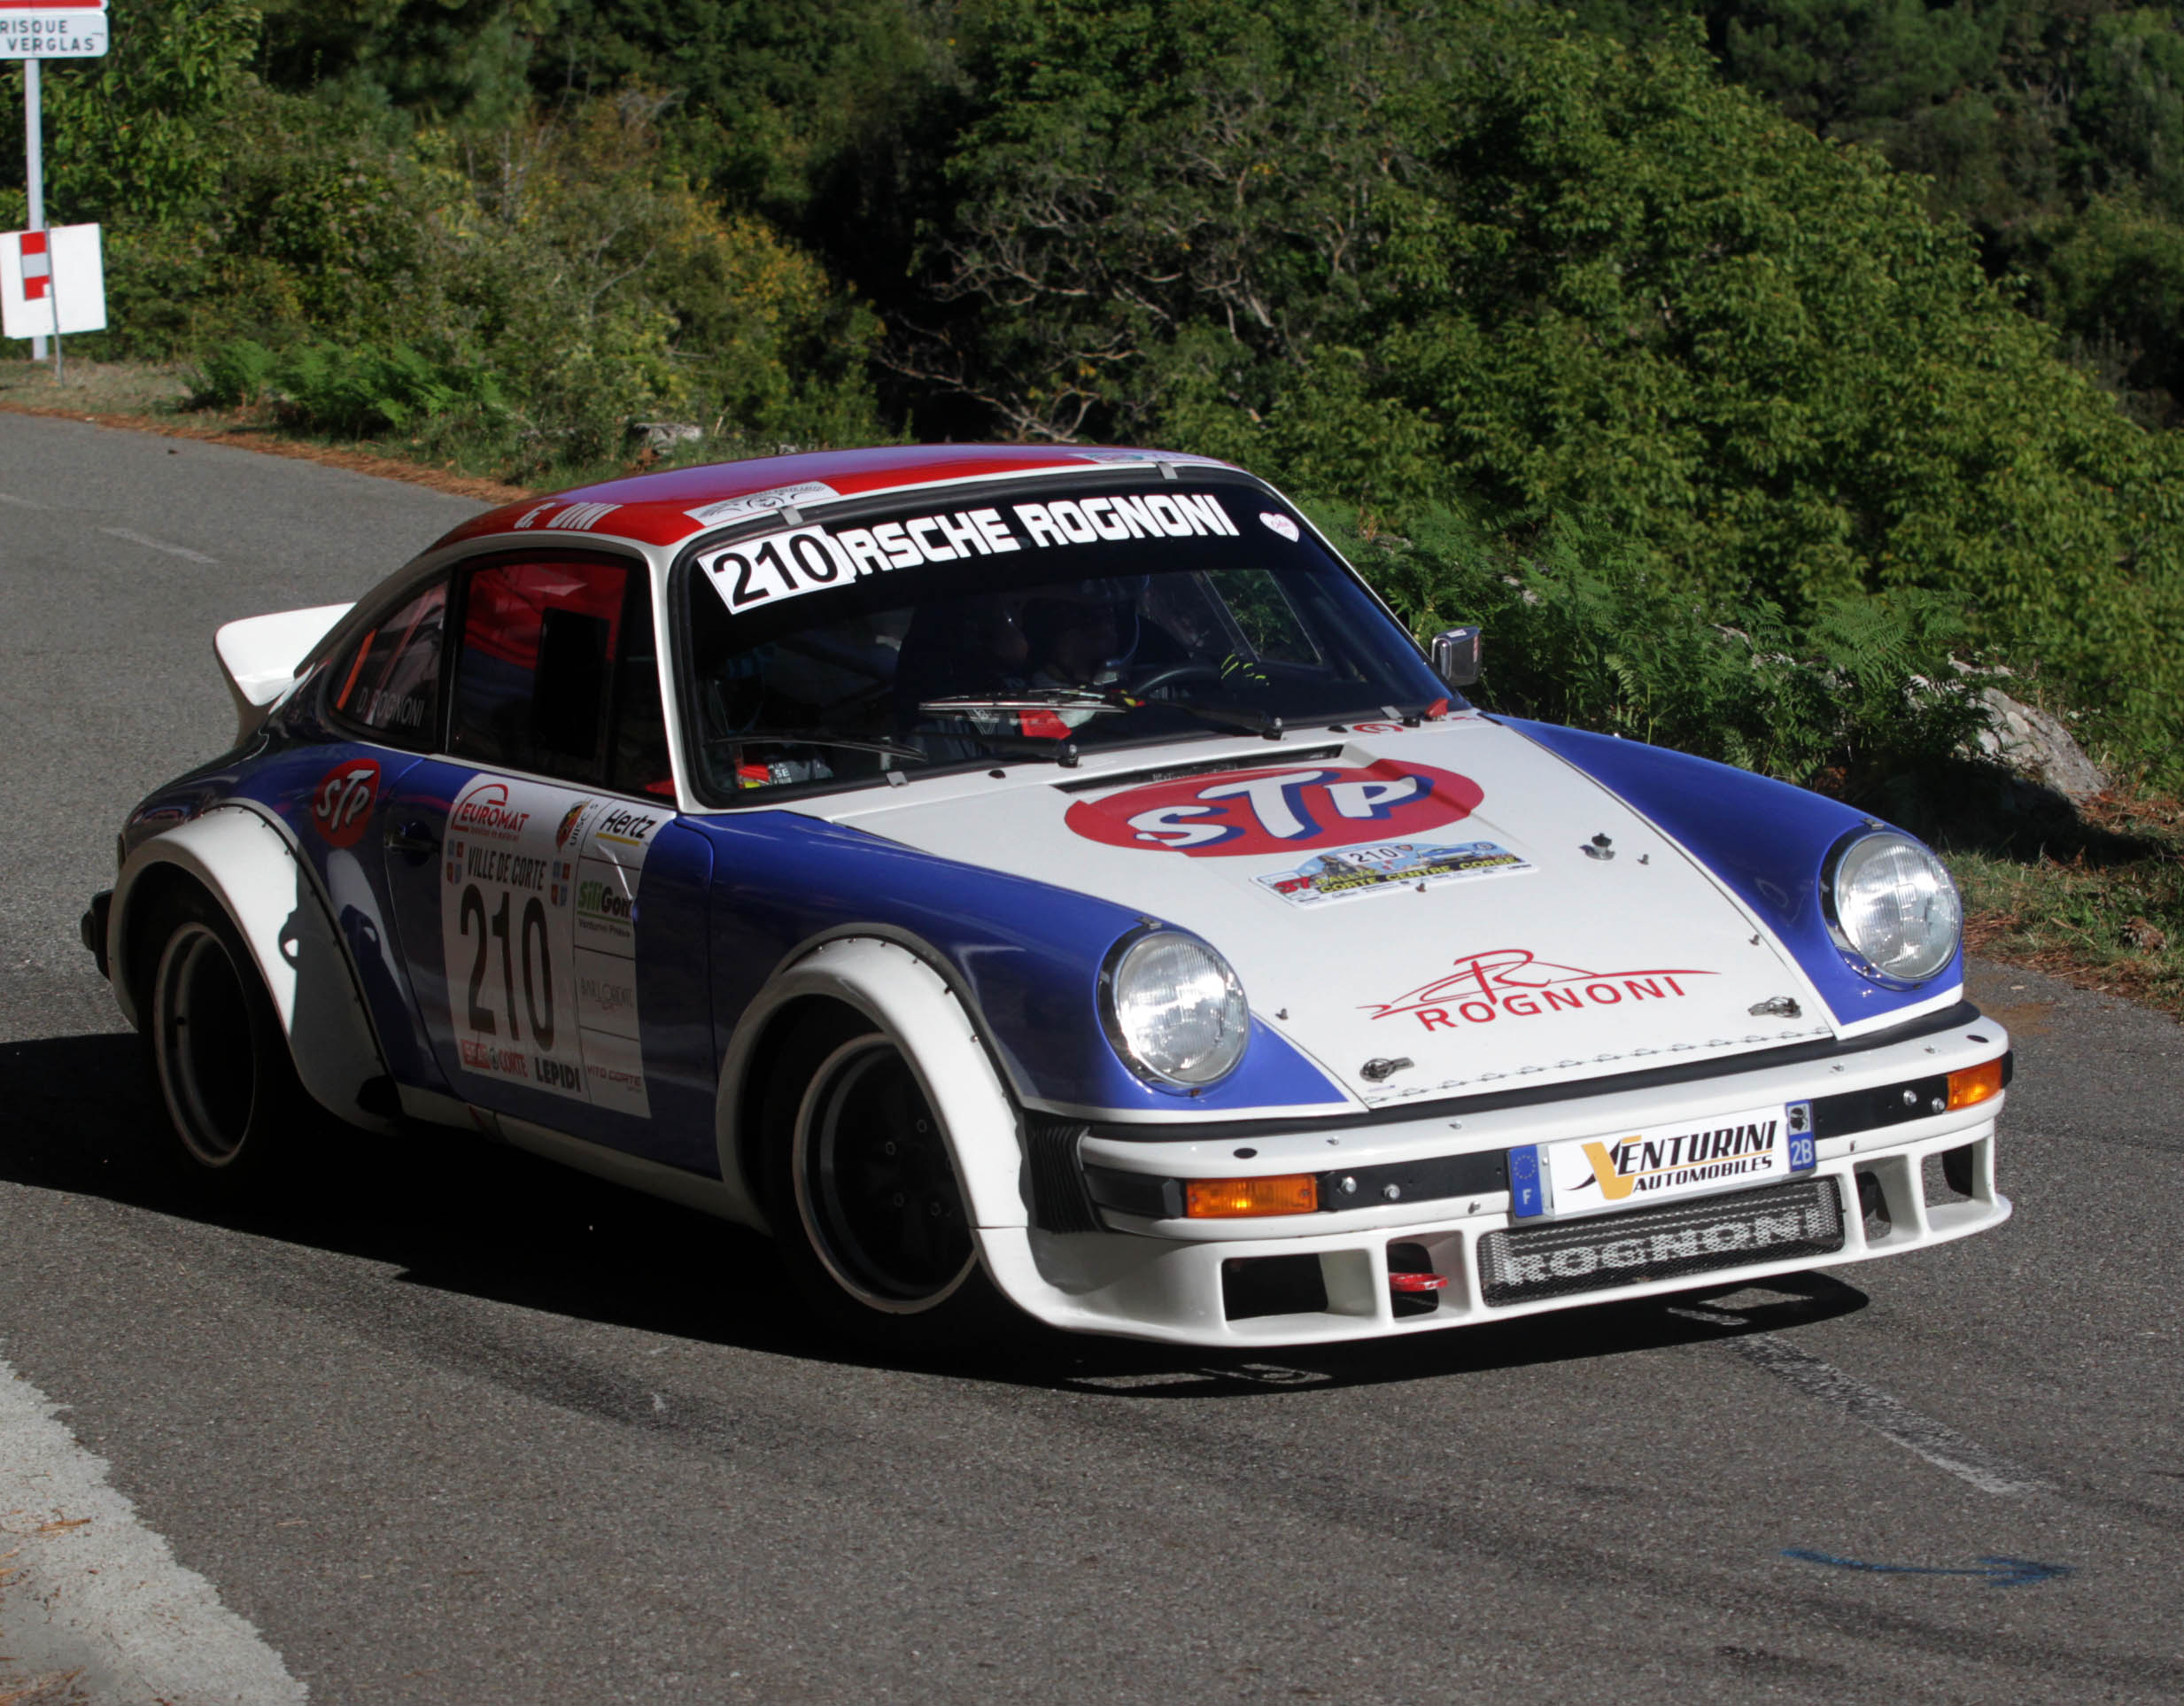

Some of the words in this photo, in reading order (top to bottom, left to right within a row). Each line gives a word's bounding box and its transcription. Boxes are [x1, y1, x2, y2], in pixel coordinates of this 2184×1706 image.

[0, 19, 67, 34] RISQUE
[7, 37, 94, 51] VERGLAS
[829, 508, 1021, 576] RSCHE
[1013, 494, 1240, 547] ROGNONI
[713, 533, 839, 608] 210
[316, 769, 376, 830] STP
[460, 803, 530, 833] EUROMAT
[1127, 770, 1422, 849] STP
[599, 809, 657, 839] Hertz
[467, 846, 495, 881] VILLE
[496, 852, 511, 883] DE
[511, 856, 547, 892] CORTE
[1320, 876, 1377, 894] CORTE
[1385, 865, 1452, 881] CENTRE
[1459, 856, 1520, 871] CORSE
[1349, 848, 1398, 864] 210
[1315, 869, 1375, 886] RALLYE
[460, 883, 554, 1052] 210
[1414, 976, 1685, 1032] ROGNONI
[534, 1057, 581, 1093] LEPIDI
[1580, 1120, 1777, 1200] VENTURINI
[1790, 1138, 1813, 1167] 2B
[1632, 1155, 1773, 1193] AUTOMOBILES
[1522, 1188, 1531, 1206] F
[1503, 1205, 1823, 1287] ROGNONI
